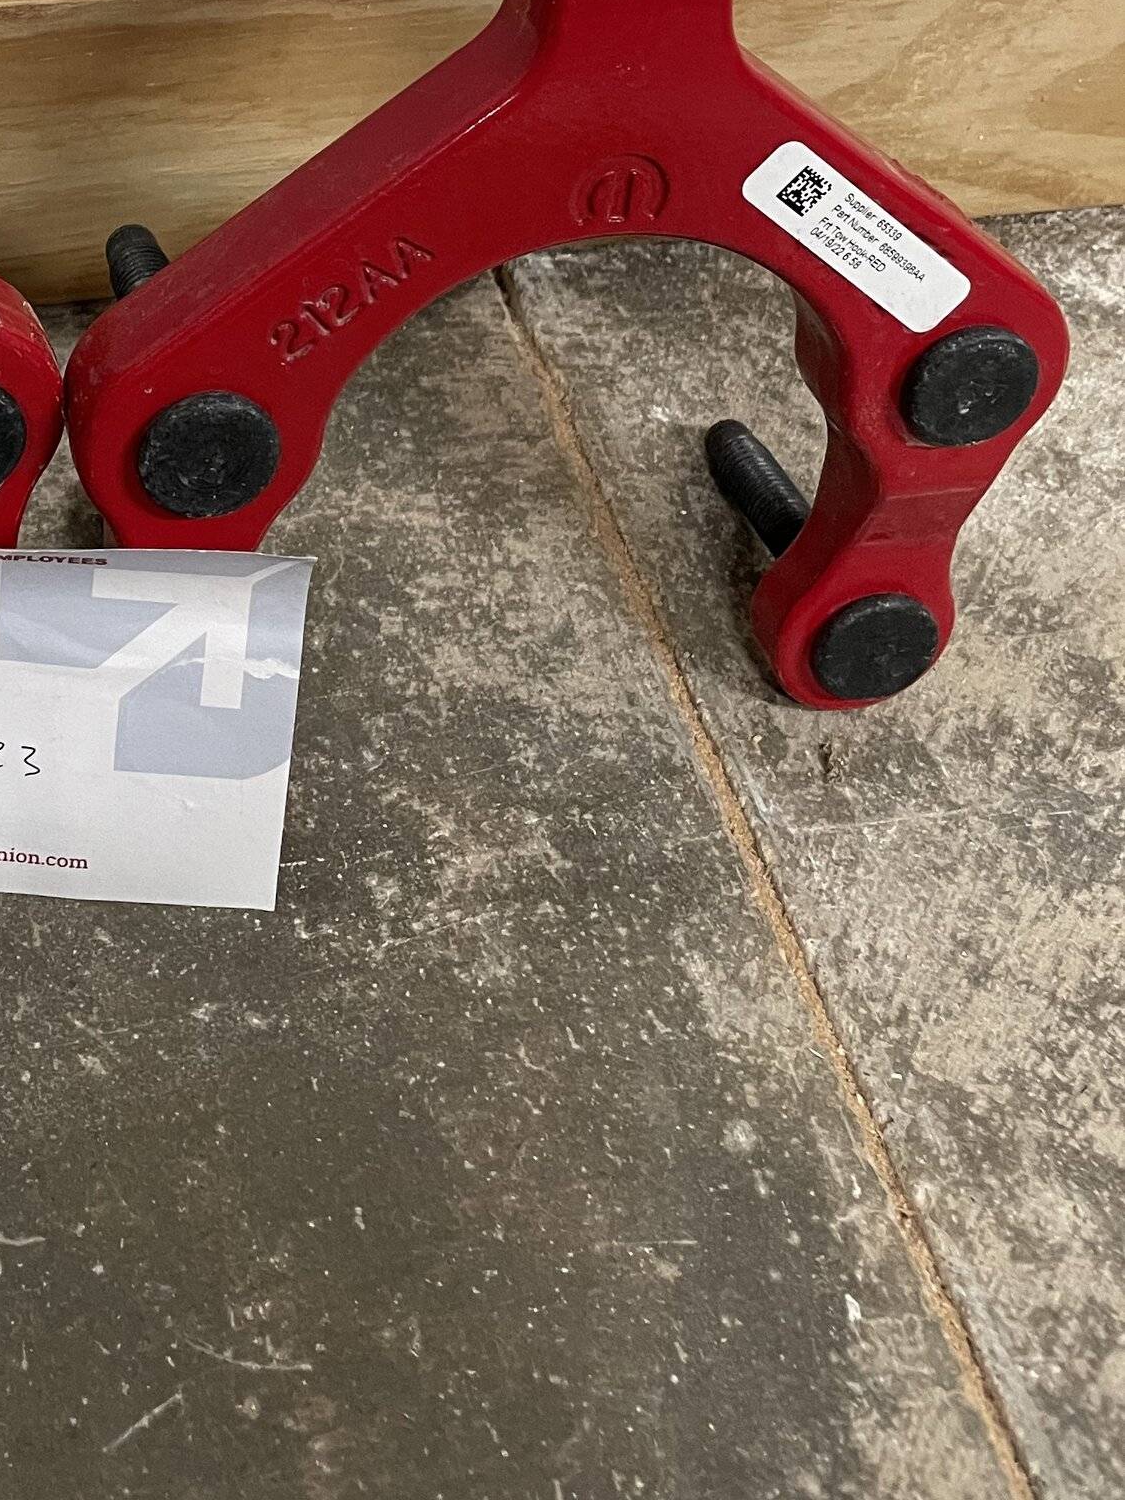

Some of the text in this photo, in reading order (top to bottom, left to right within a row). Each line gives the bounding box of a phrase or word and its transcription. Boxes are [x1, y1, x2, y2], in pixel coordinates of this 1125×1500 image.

[831, 204, 851, 222] Part
[810, 227, 845, 256] 04/19/22
[818, 217, 833, 231] Frt
[831, 226, 848, 242] Tow
[876, 219, 903, 241] 65339
[269, 235, 436, 367] 212AA
